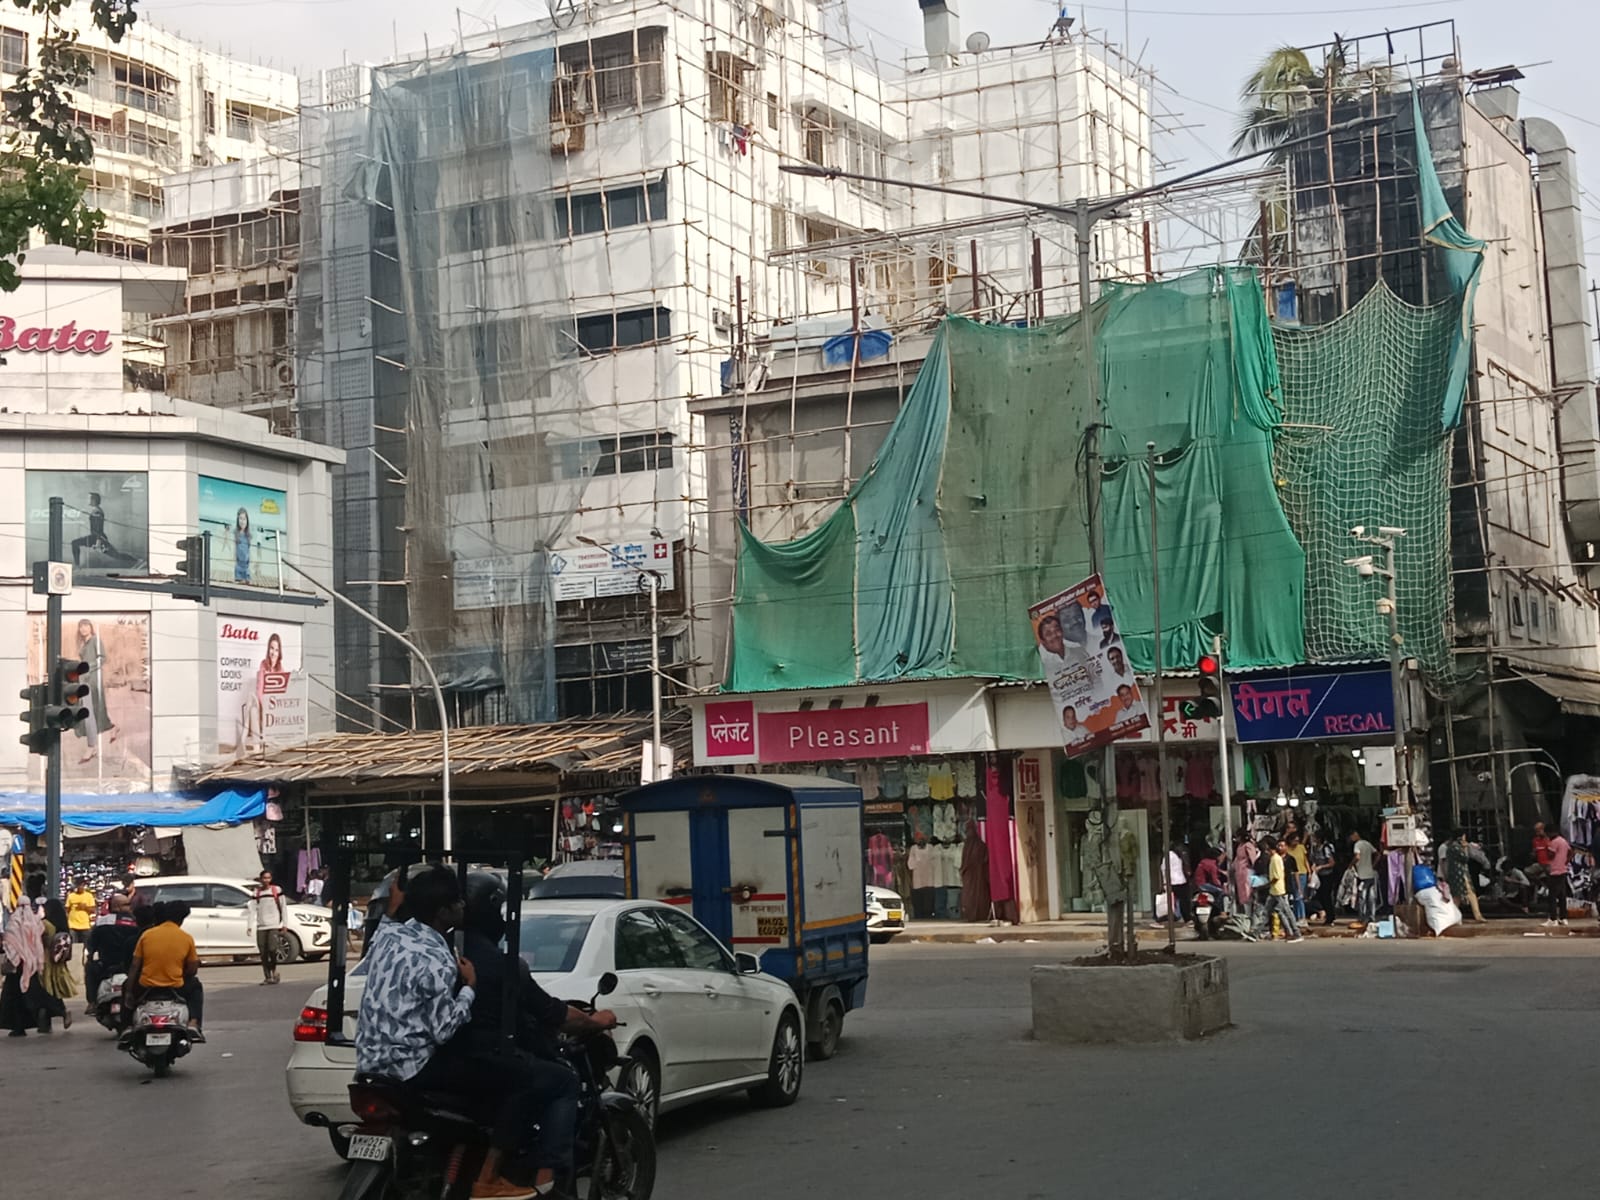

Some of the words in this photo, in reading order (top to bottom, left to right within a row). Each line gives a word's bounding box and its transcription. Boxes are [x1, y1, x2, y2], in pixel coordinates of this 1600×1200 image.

[0, 316, 112, 353] Bata
[220, 623, 259, 641] Bata
[220, 657, 251, 668] COMFORT
[220, 669, 242, 679] LOOKS
[220, 682, 242, 692] GREAT
[1235, 683, 1311, 722] रीगल
[710, 715, 750, 743] प्लेजंट
[1324, 712, 1391, 733] REGAL
[789, 720, 900, 749] Pleasant
